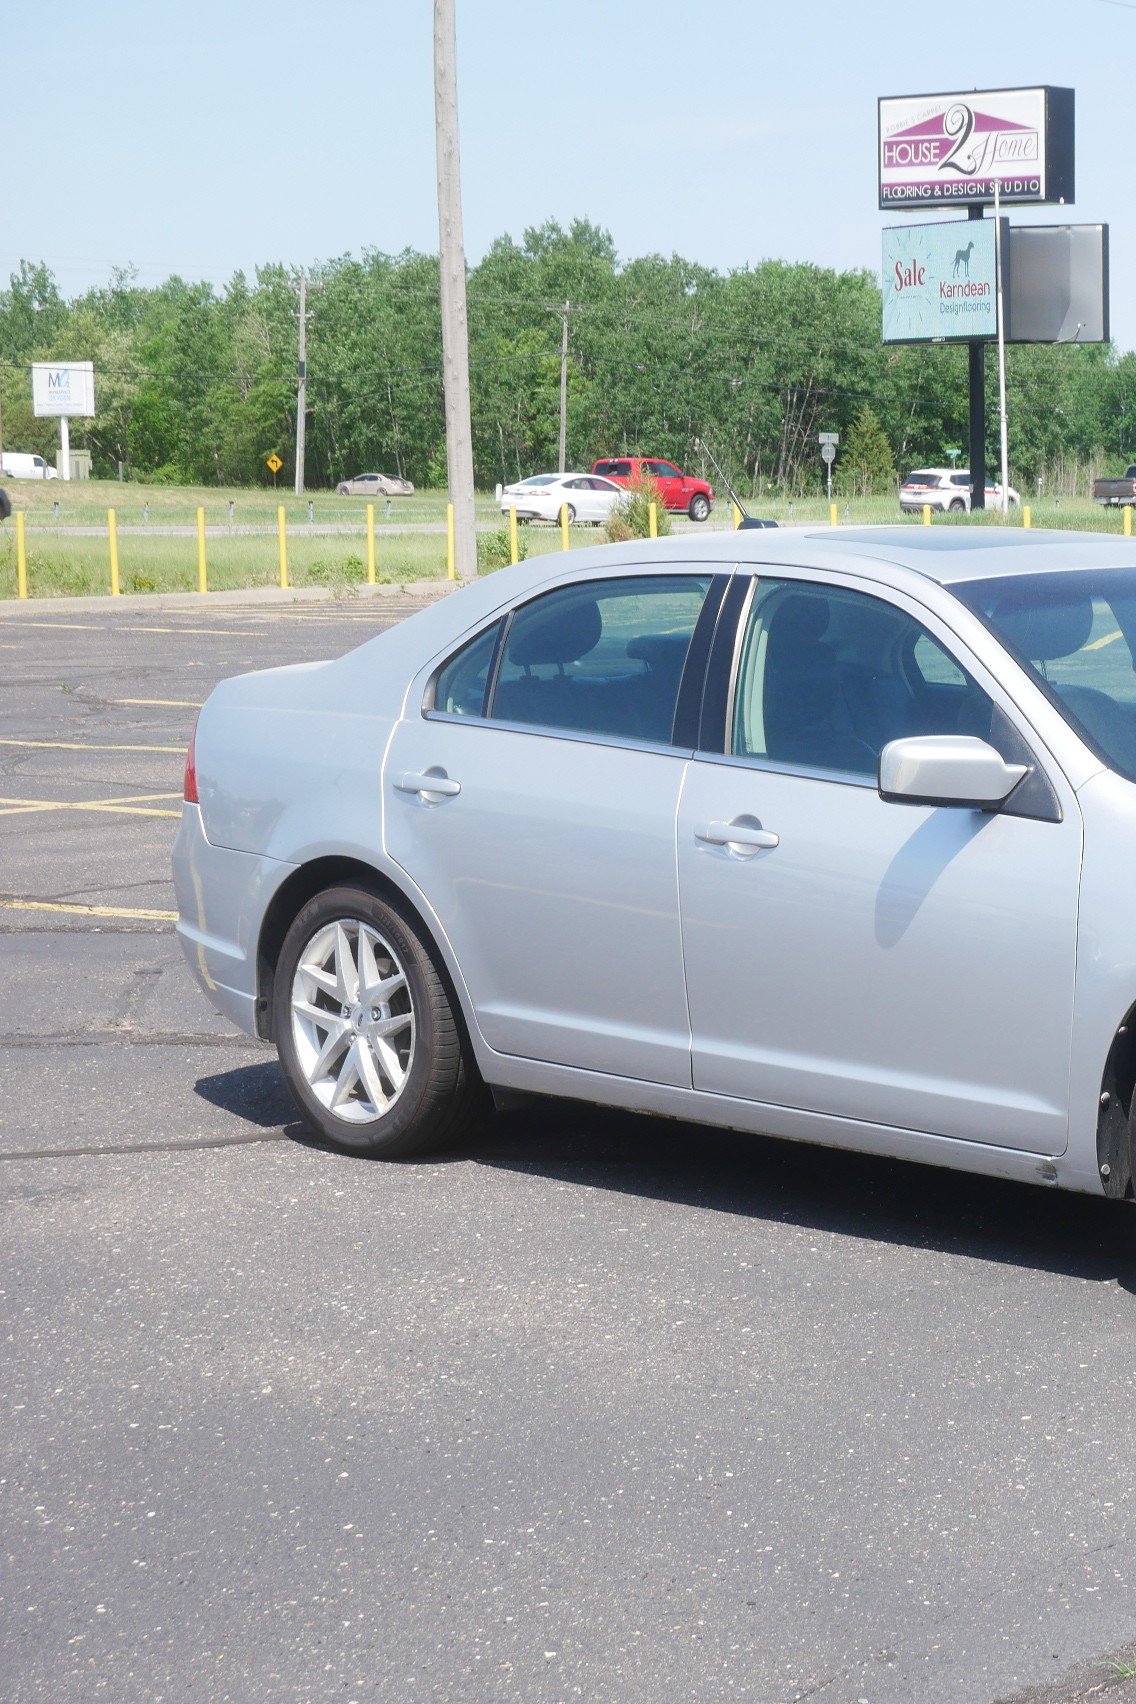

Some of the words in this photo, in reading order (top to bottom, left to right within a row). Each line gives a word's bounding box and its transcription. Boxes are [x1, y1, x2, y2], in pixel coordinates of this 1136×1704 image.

[885, 142, 940, 164] HOUSE
[938, 103, 976, 176] 2
[972, 131, 1035, 176] Home
[883, 184, 931, 198] FLOORING
[934, 185, 941, 196] &
[944, 181, 985, 196] DESIGN
[895, 258, 925, 291] Sale
[940, 280, 990, 298] Karndean
[940, 300, 990, 315] Designflooring
